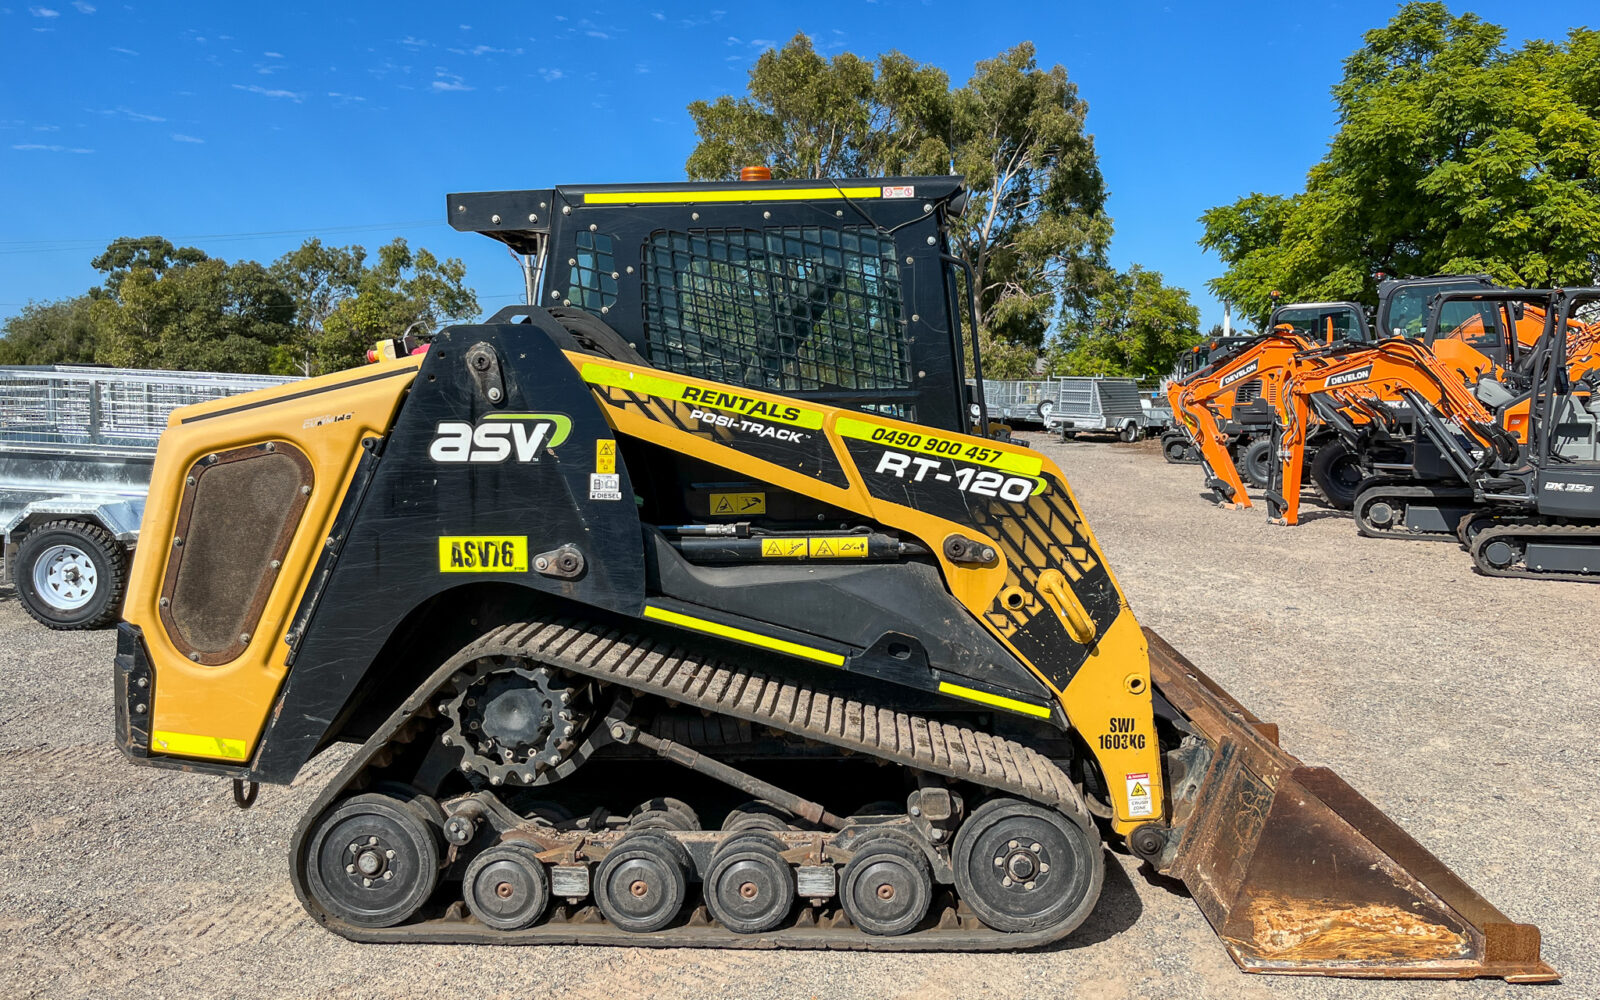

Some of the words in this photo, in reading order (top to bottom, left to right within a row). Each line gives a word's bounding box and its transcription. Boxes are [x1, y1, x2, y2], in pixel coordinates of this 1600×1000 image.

[1225, 363, 1257, 384] DEVELON
[1331, 370, 1369, 385] DEVELON
[681, 386, 801, 421] RENTALS
[689, 409, 804, 443] POSI-TRACK
[871, 428, 921, 448] 0490
[924, 438, 963, 456] 900
[965, 445, 1003, 464] 457
[875, 450, 1033, 503] RT-120
[451, 541, 514, 568] ASV76
[1098, 734, 1146, 750] 1603KG
